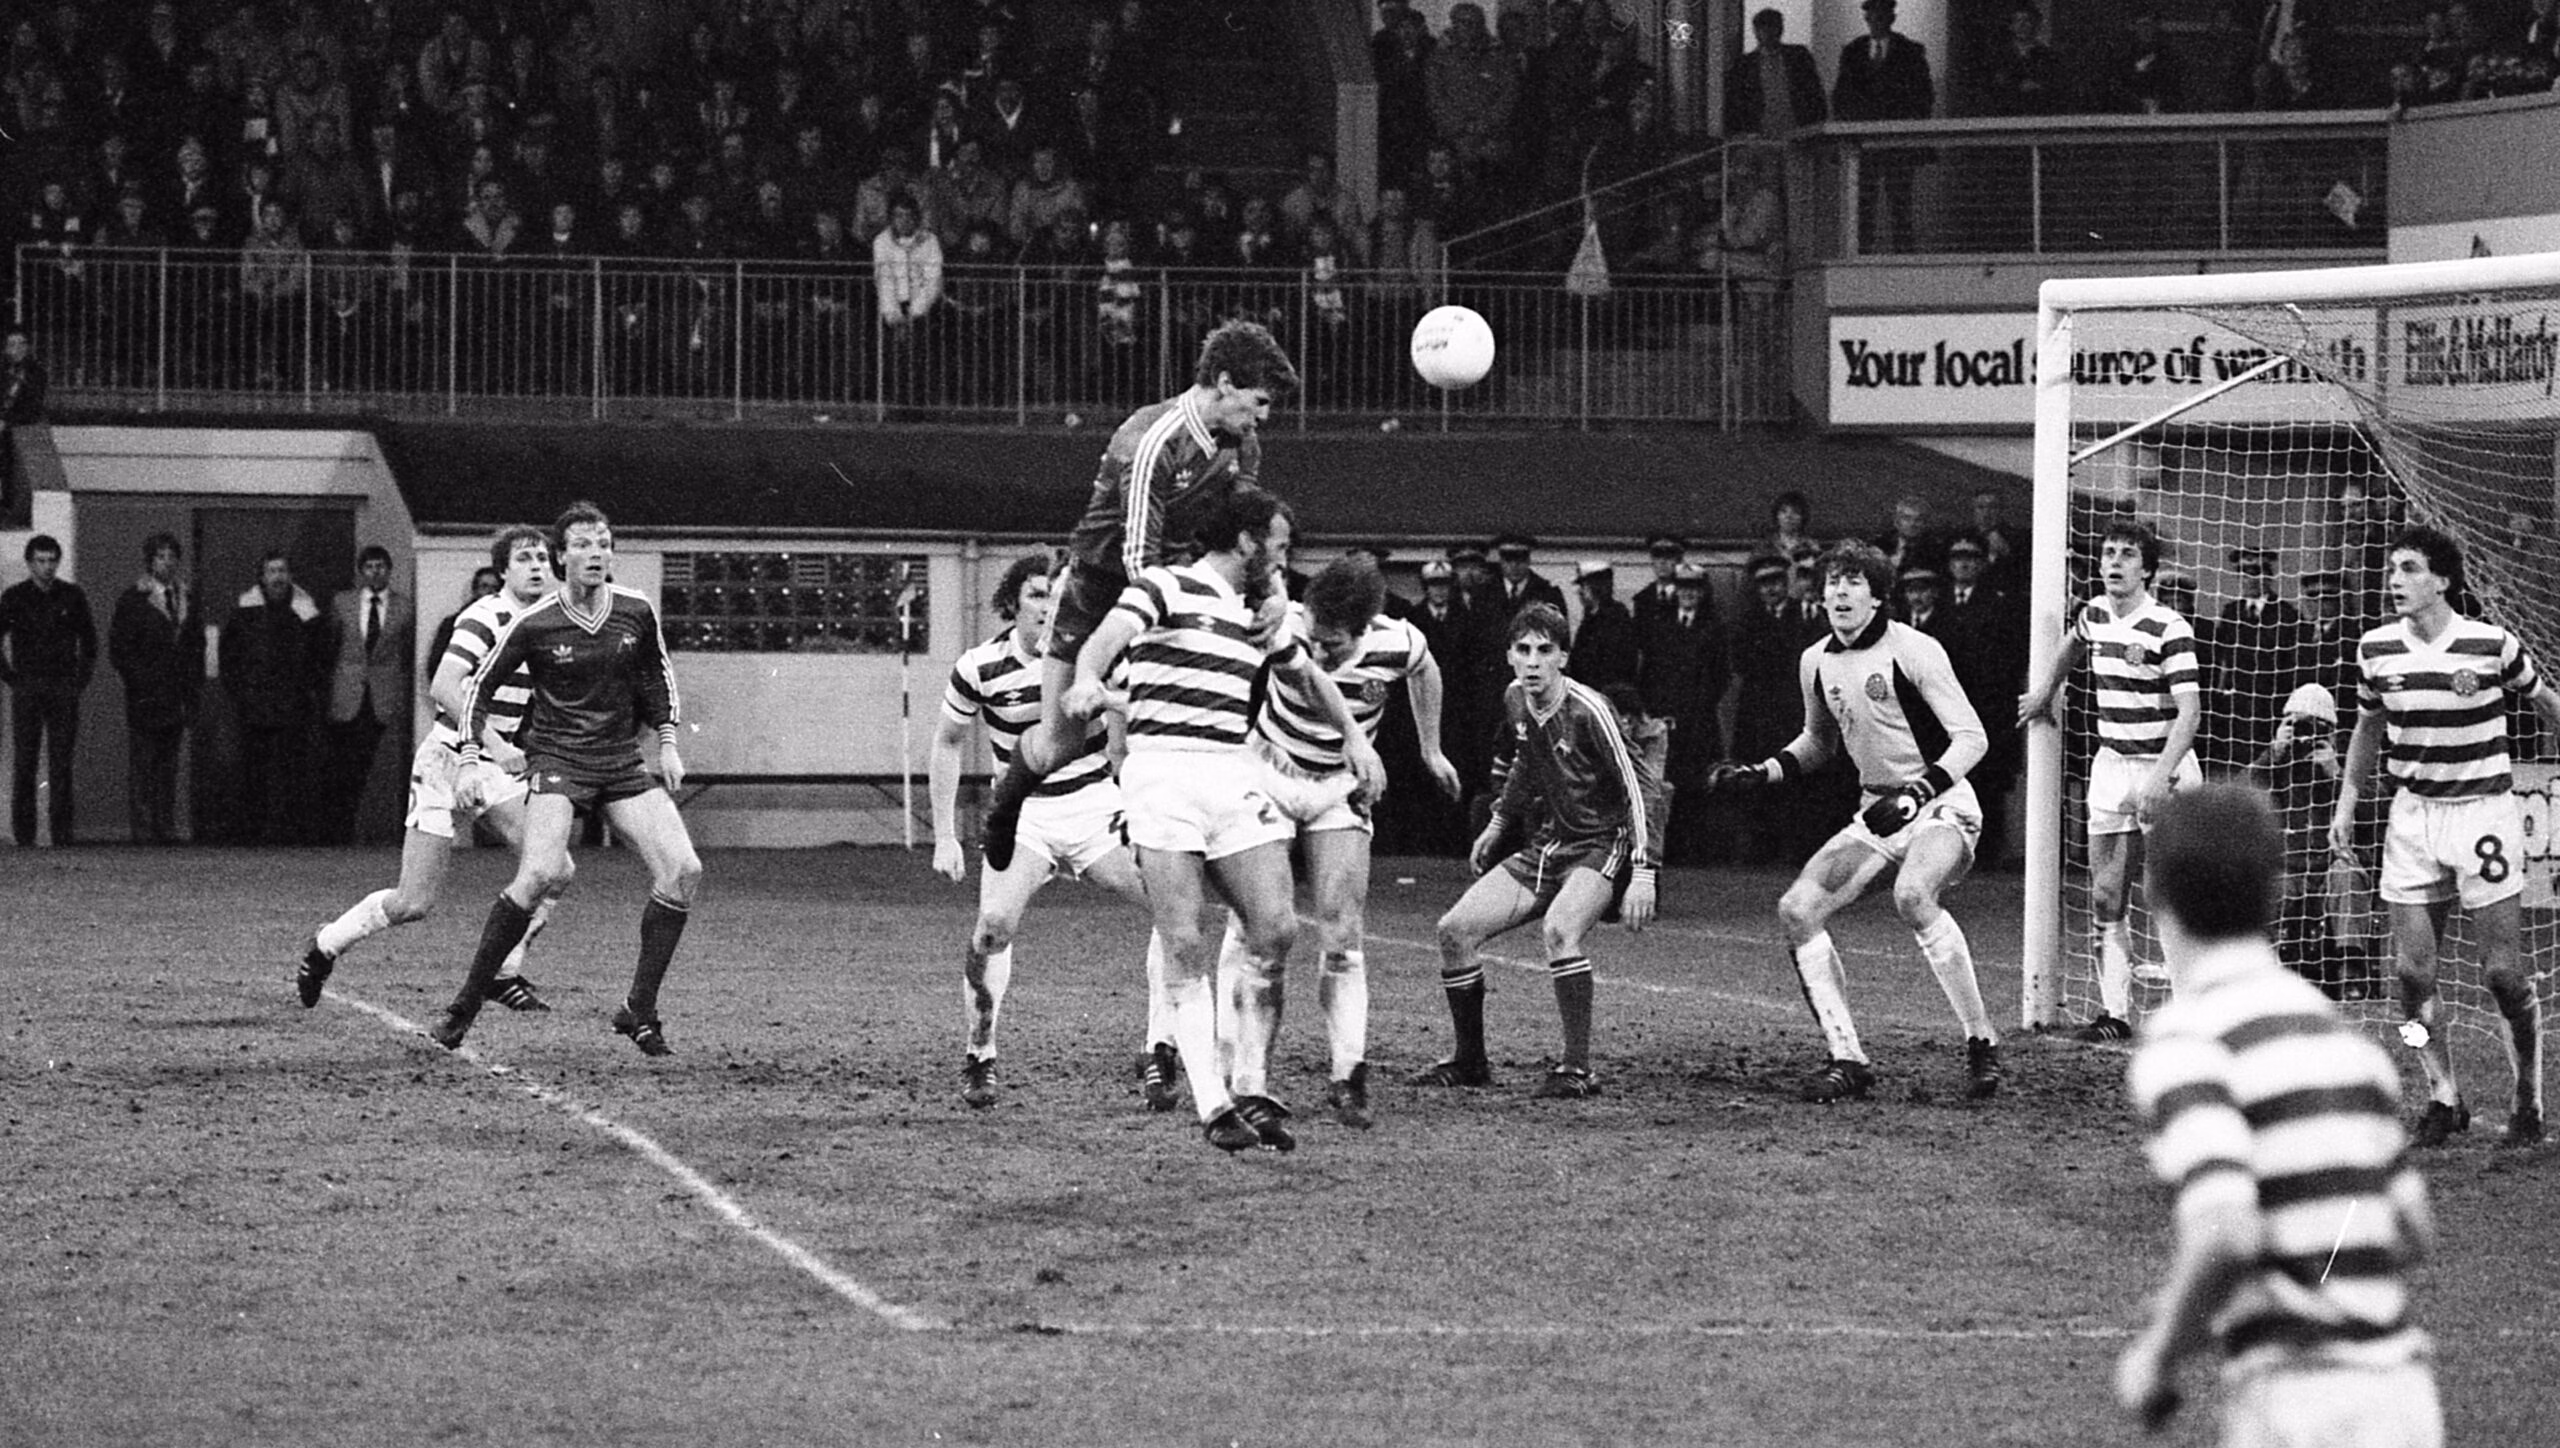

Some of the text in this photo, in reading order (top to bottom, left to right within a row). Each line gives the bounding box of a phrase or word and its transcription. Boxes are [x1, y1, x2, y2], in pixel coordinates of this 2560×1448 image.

[1839, 339, 1926, 388] Your
[1934, 338, 2025, 387] local
[2031, 347, 2157, 386] urce
[2164, 335, 2206, 384] of
[2474, 834, 2509, 883] 8
